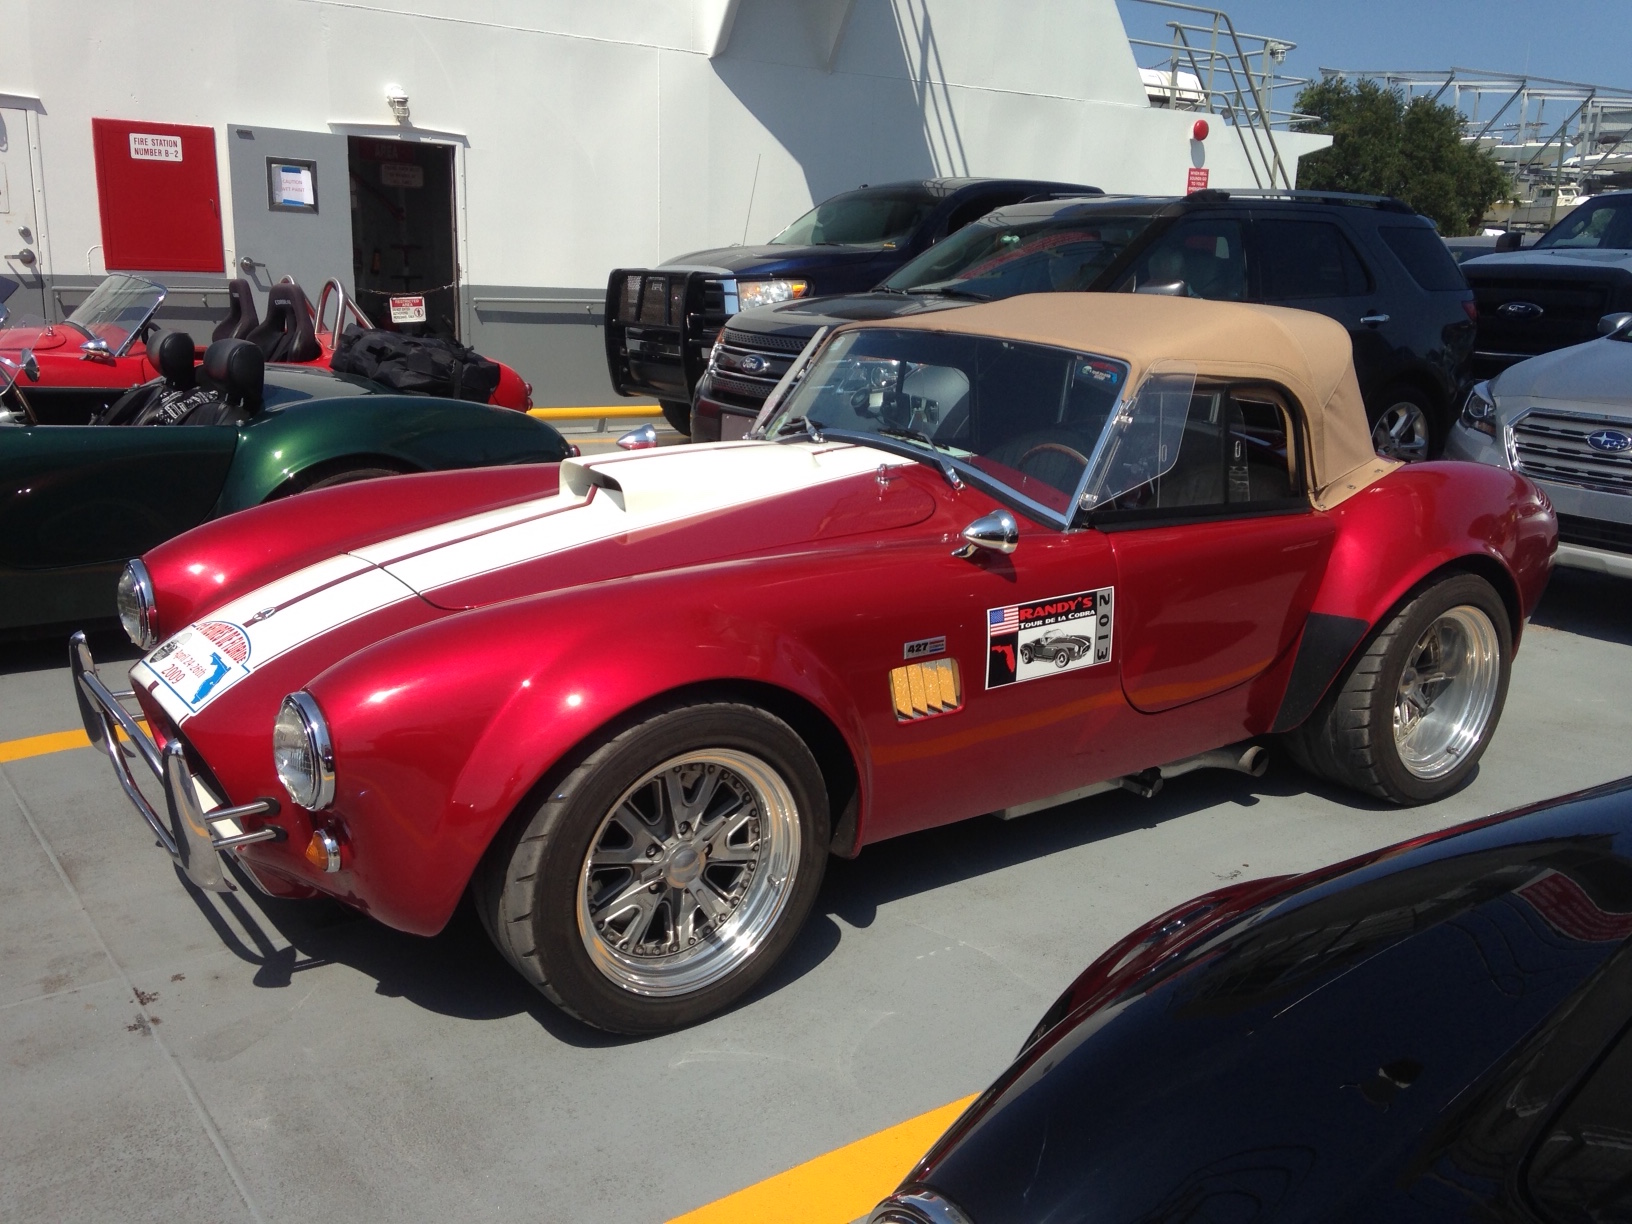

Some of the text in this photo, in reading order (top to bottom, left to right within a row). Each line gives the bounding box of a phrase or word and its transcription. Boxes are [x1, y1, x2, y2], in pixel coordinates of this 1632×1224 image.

[133, 137, 178, 148] FIRE STATION
[134, 147, 179, 158] NUMBER B-2
[742, 357, 759, 369] Ford
[1019, 596, 1093, 620] RANDY'S
[1096, 593, 1111, 661] 2013
[220, 636, 247, 664] FLORIDE
[907, 642, 929, 654] 427
[161, 663, 186, 684] 2009
